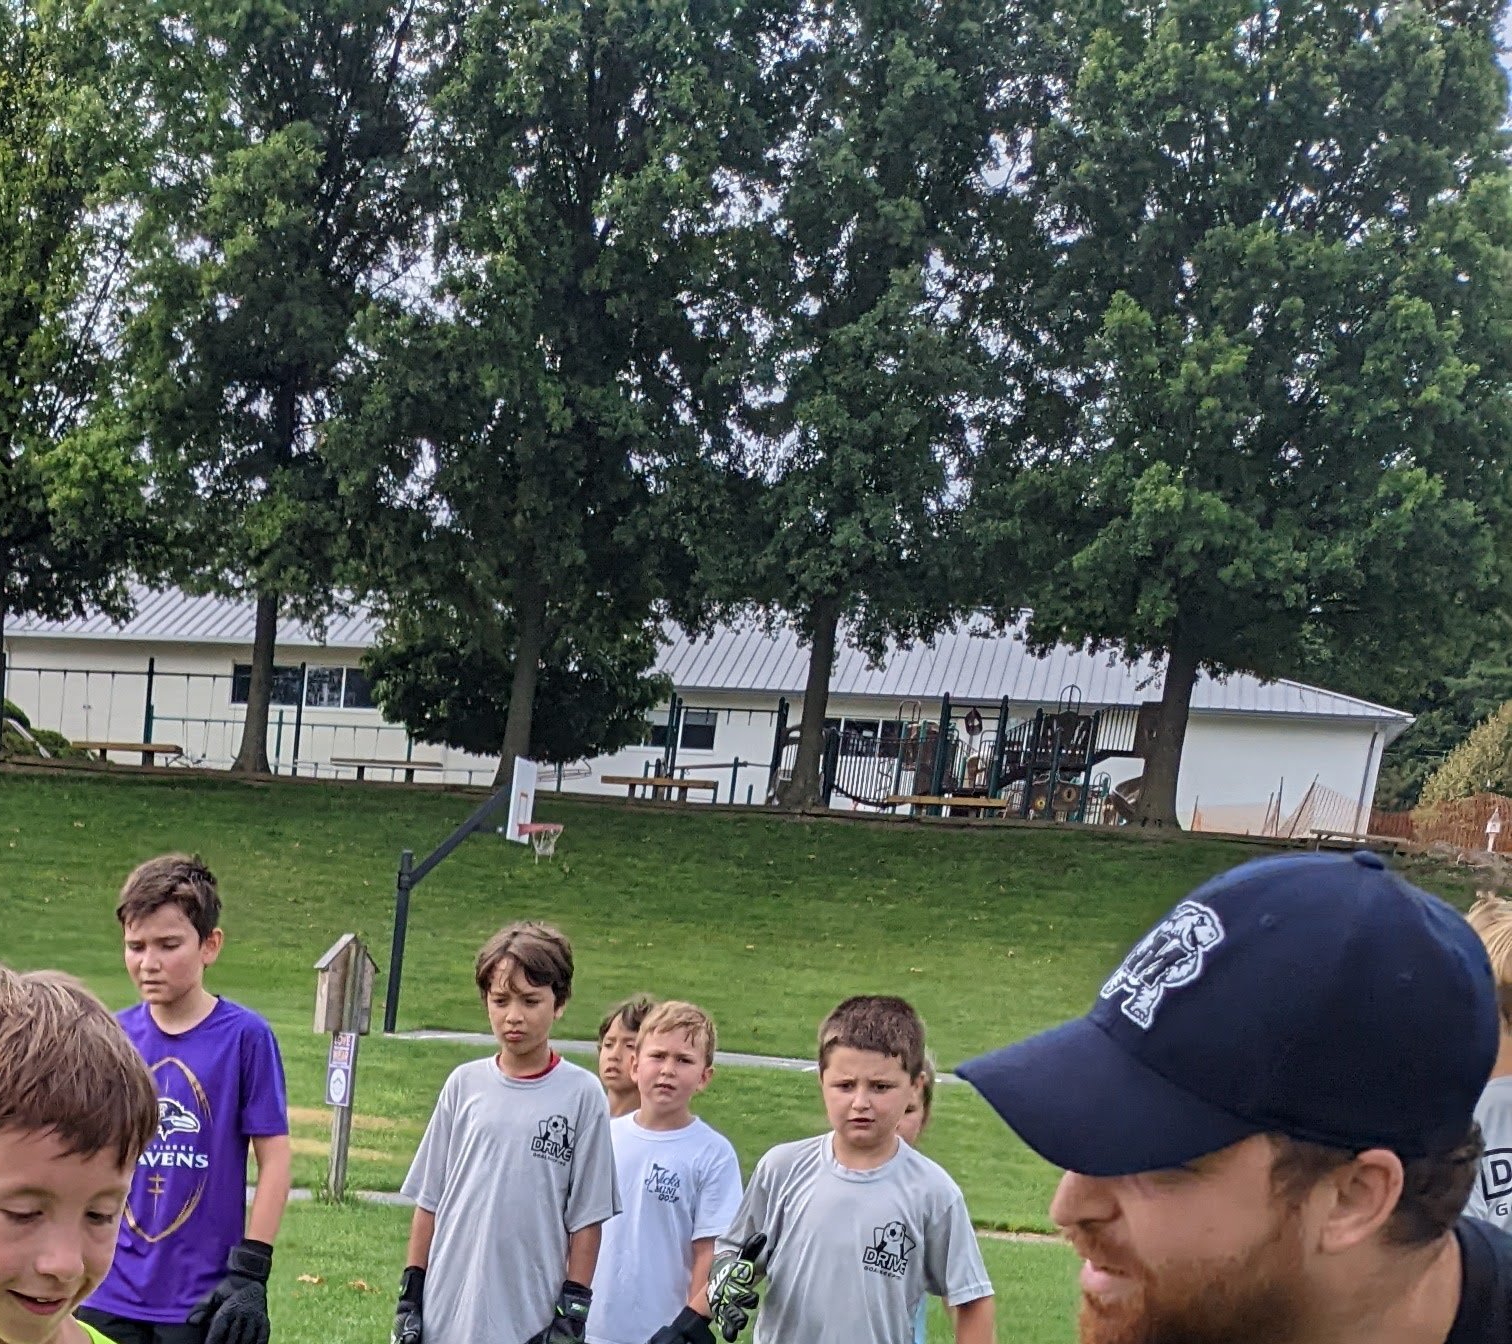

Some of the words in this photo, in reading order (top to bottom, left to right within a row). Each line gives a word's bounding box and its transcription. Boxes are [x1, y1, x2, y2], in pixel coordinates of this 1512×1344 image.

[138, 1151, 208, 1168] AVENS
[531, 1136, 574, 1162] DRIVE
[1496, 1202, 1512, 1216] G
[862, 1246, 909, 1275] DRIVE
